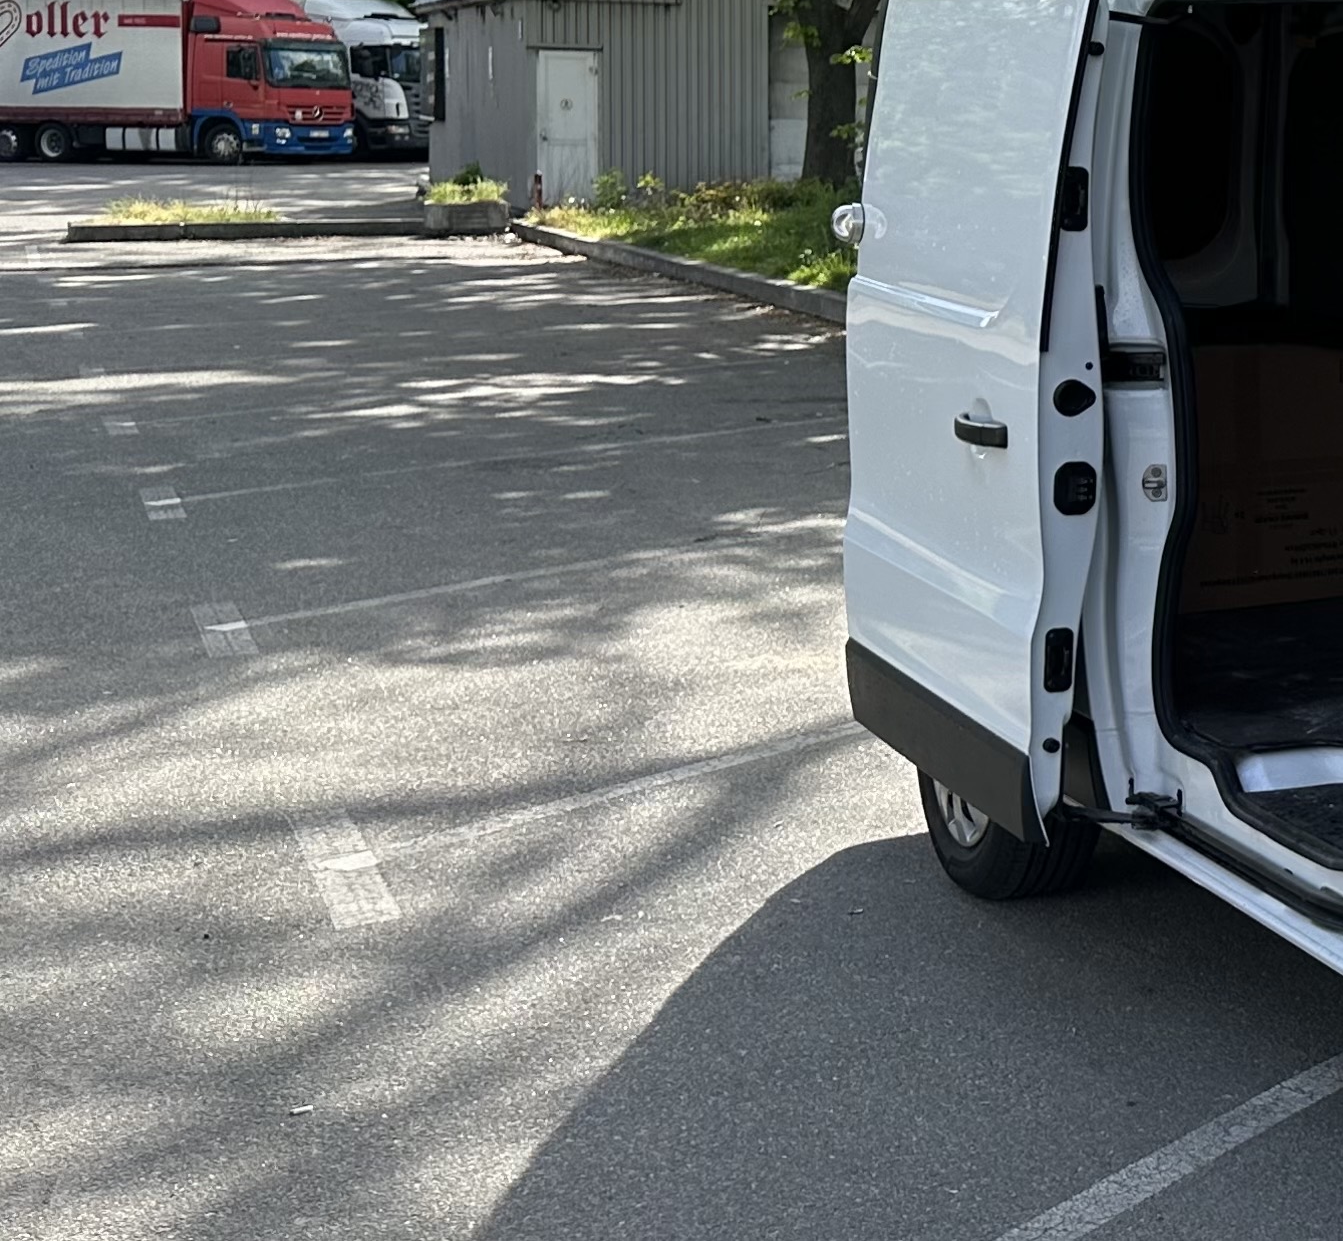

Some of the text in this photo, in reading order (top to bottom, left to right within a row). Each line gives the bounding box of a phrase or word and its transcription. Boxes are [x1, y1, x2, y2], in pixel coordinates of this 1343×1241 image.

[26, 49, 87, 77] Spedition
[36, 58, 119, 90] mit Tradition
